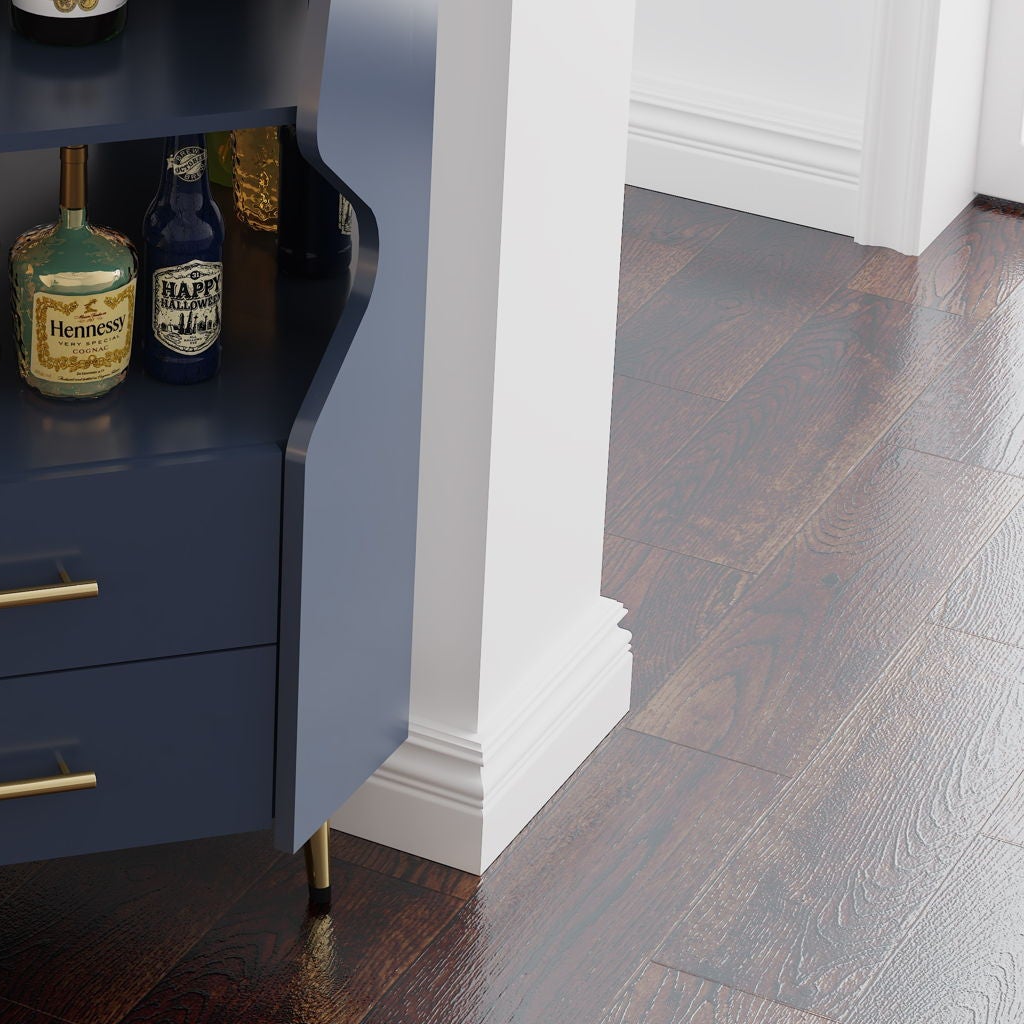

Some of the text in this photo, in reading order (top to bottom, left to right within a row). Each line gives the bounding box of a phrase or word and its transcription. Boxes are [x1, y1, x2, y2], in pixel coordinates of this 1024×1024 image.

[161, 274, 221, 300] HAPPY
[50, 314, 126, 338] Hennessy
[72, 344, 109, 355] COGNAC
[85, 334, 120, 347] SPECIAL
